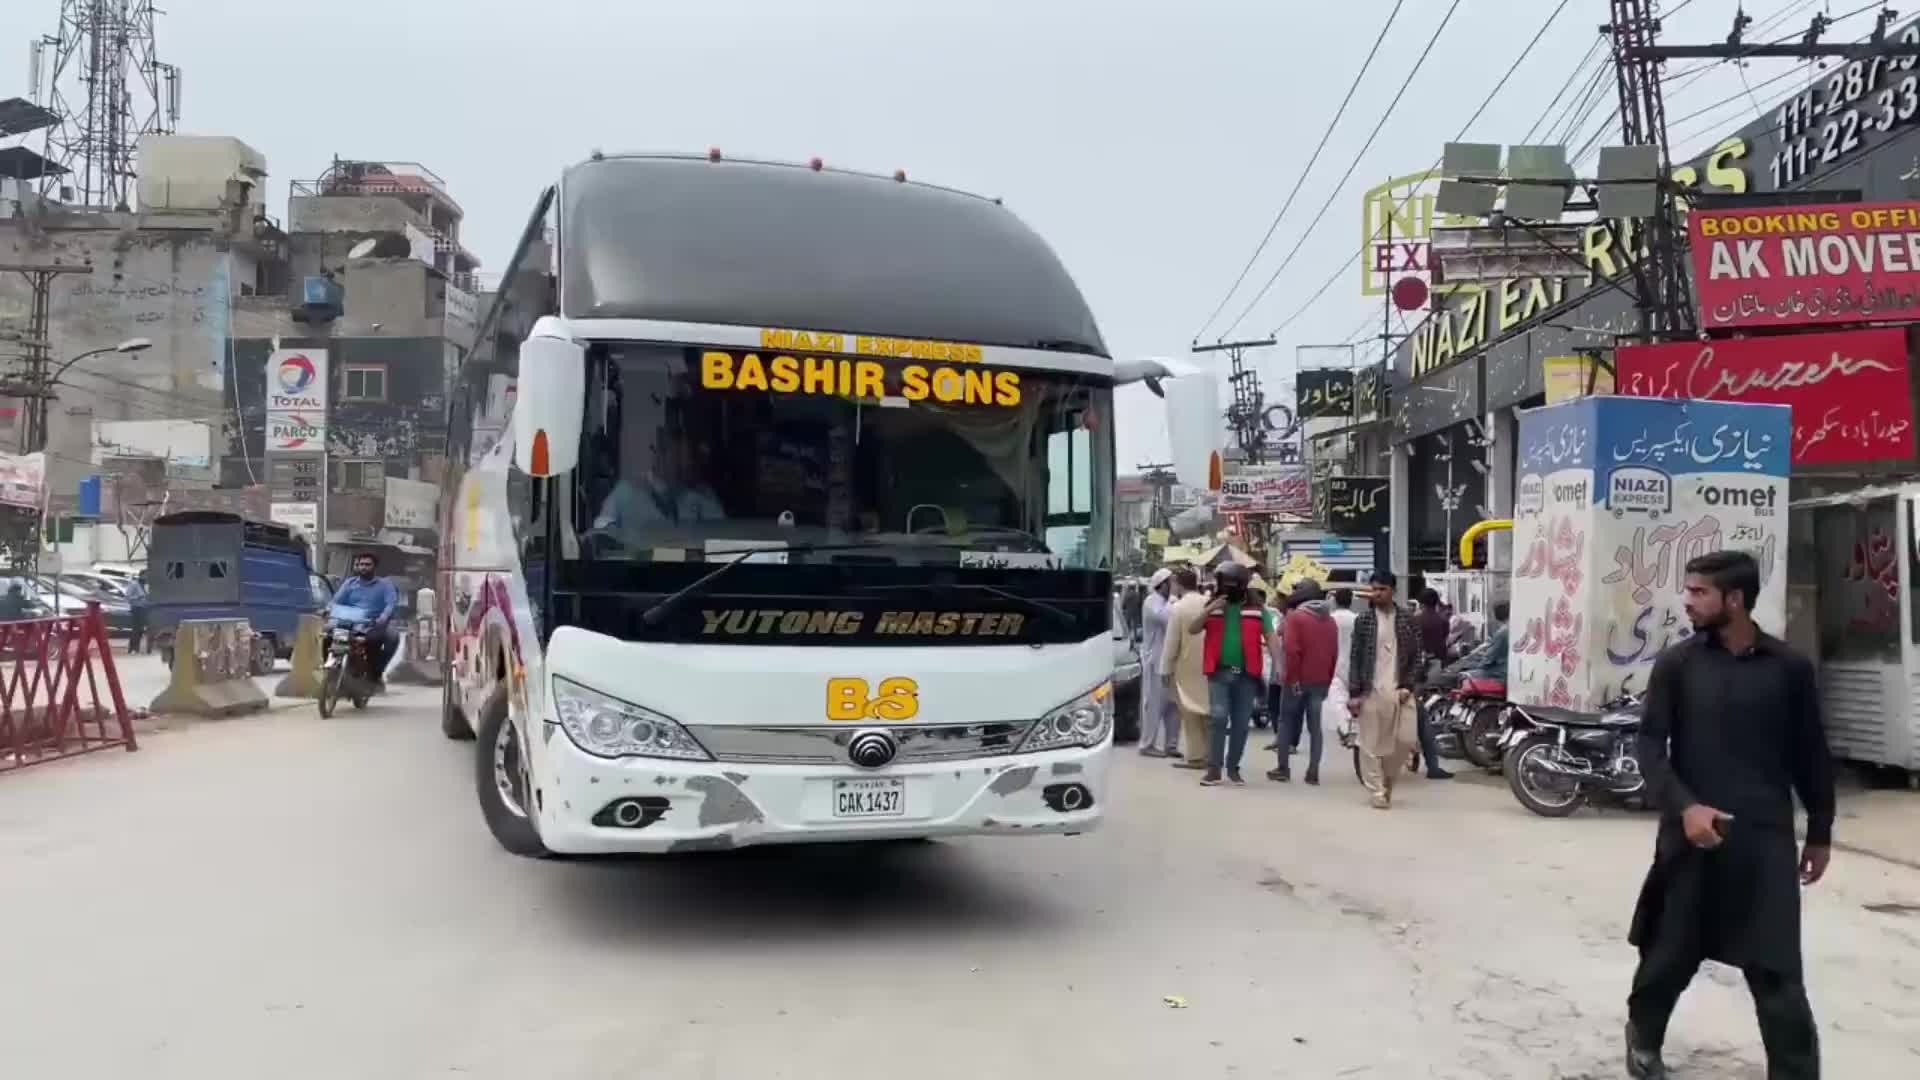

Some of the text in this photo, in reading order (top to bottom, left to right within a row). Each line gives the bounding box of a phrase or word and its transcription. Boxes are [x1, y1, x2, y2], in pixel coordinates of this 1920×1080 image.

[1701, 212, 1841, 236] BOOKING
[1710, 239, 1770, 279] AK
[1713, 293, 1766, 321] ملتان
[760, 328, 983, 363] NIAZI EXPRESS
[1411, 290, 1487, 378] NIAZI
[702, 351, 1021, 406] BASHIR SONS
[272, 396, 321, 407] TOTAL
[1300, 380, 1351, 411] پشاور
[273, 426, 317, 438] PARCO
[1613, 421, 1772, 470] نیازی ایکسپریس
[1555, 479, 1587, 502] omet
[1613, 494, 1665, 505] EXPRESS
[1614, 478, 1665, 493] NIAZI
[1696, 478, 1777, 507] omet
[701, 610, 1025, 636] YUTONG MASTER
[1513, 594, 1583, 677] پشاور
[840, 791, 899, 812] CAK 1437
